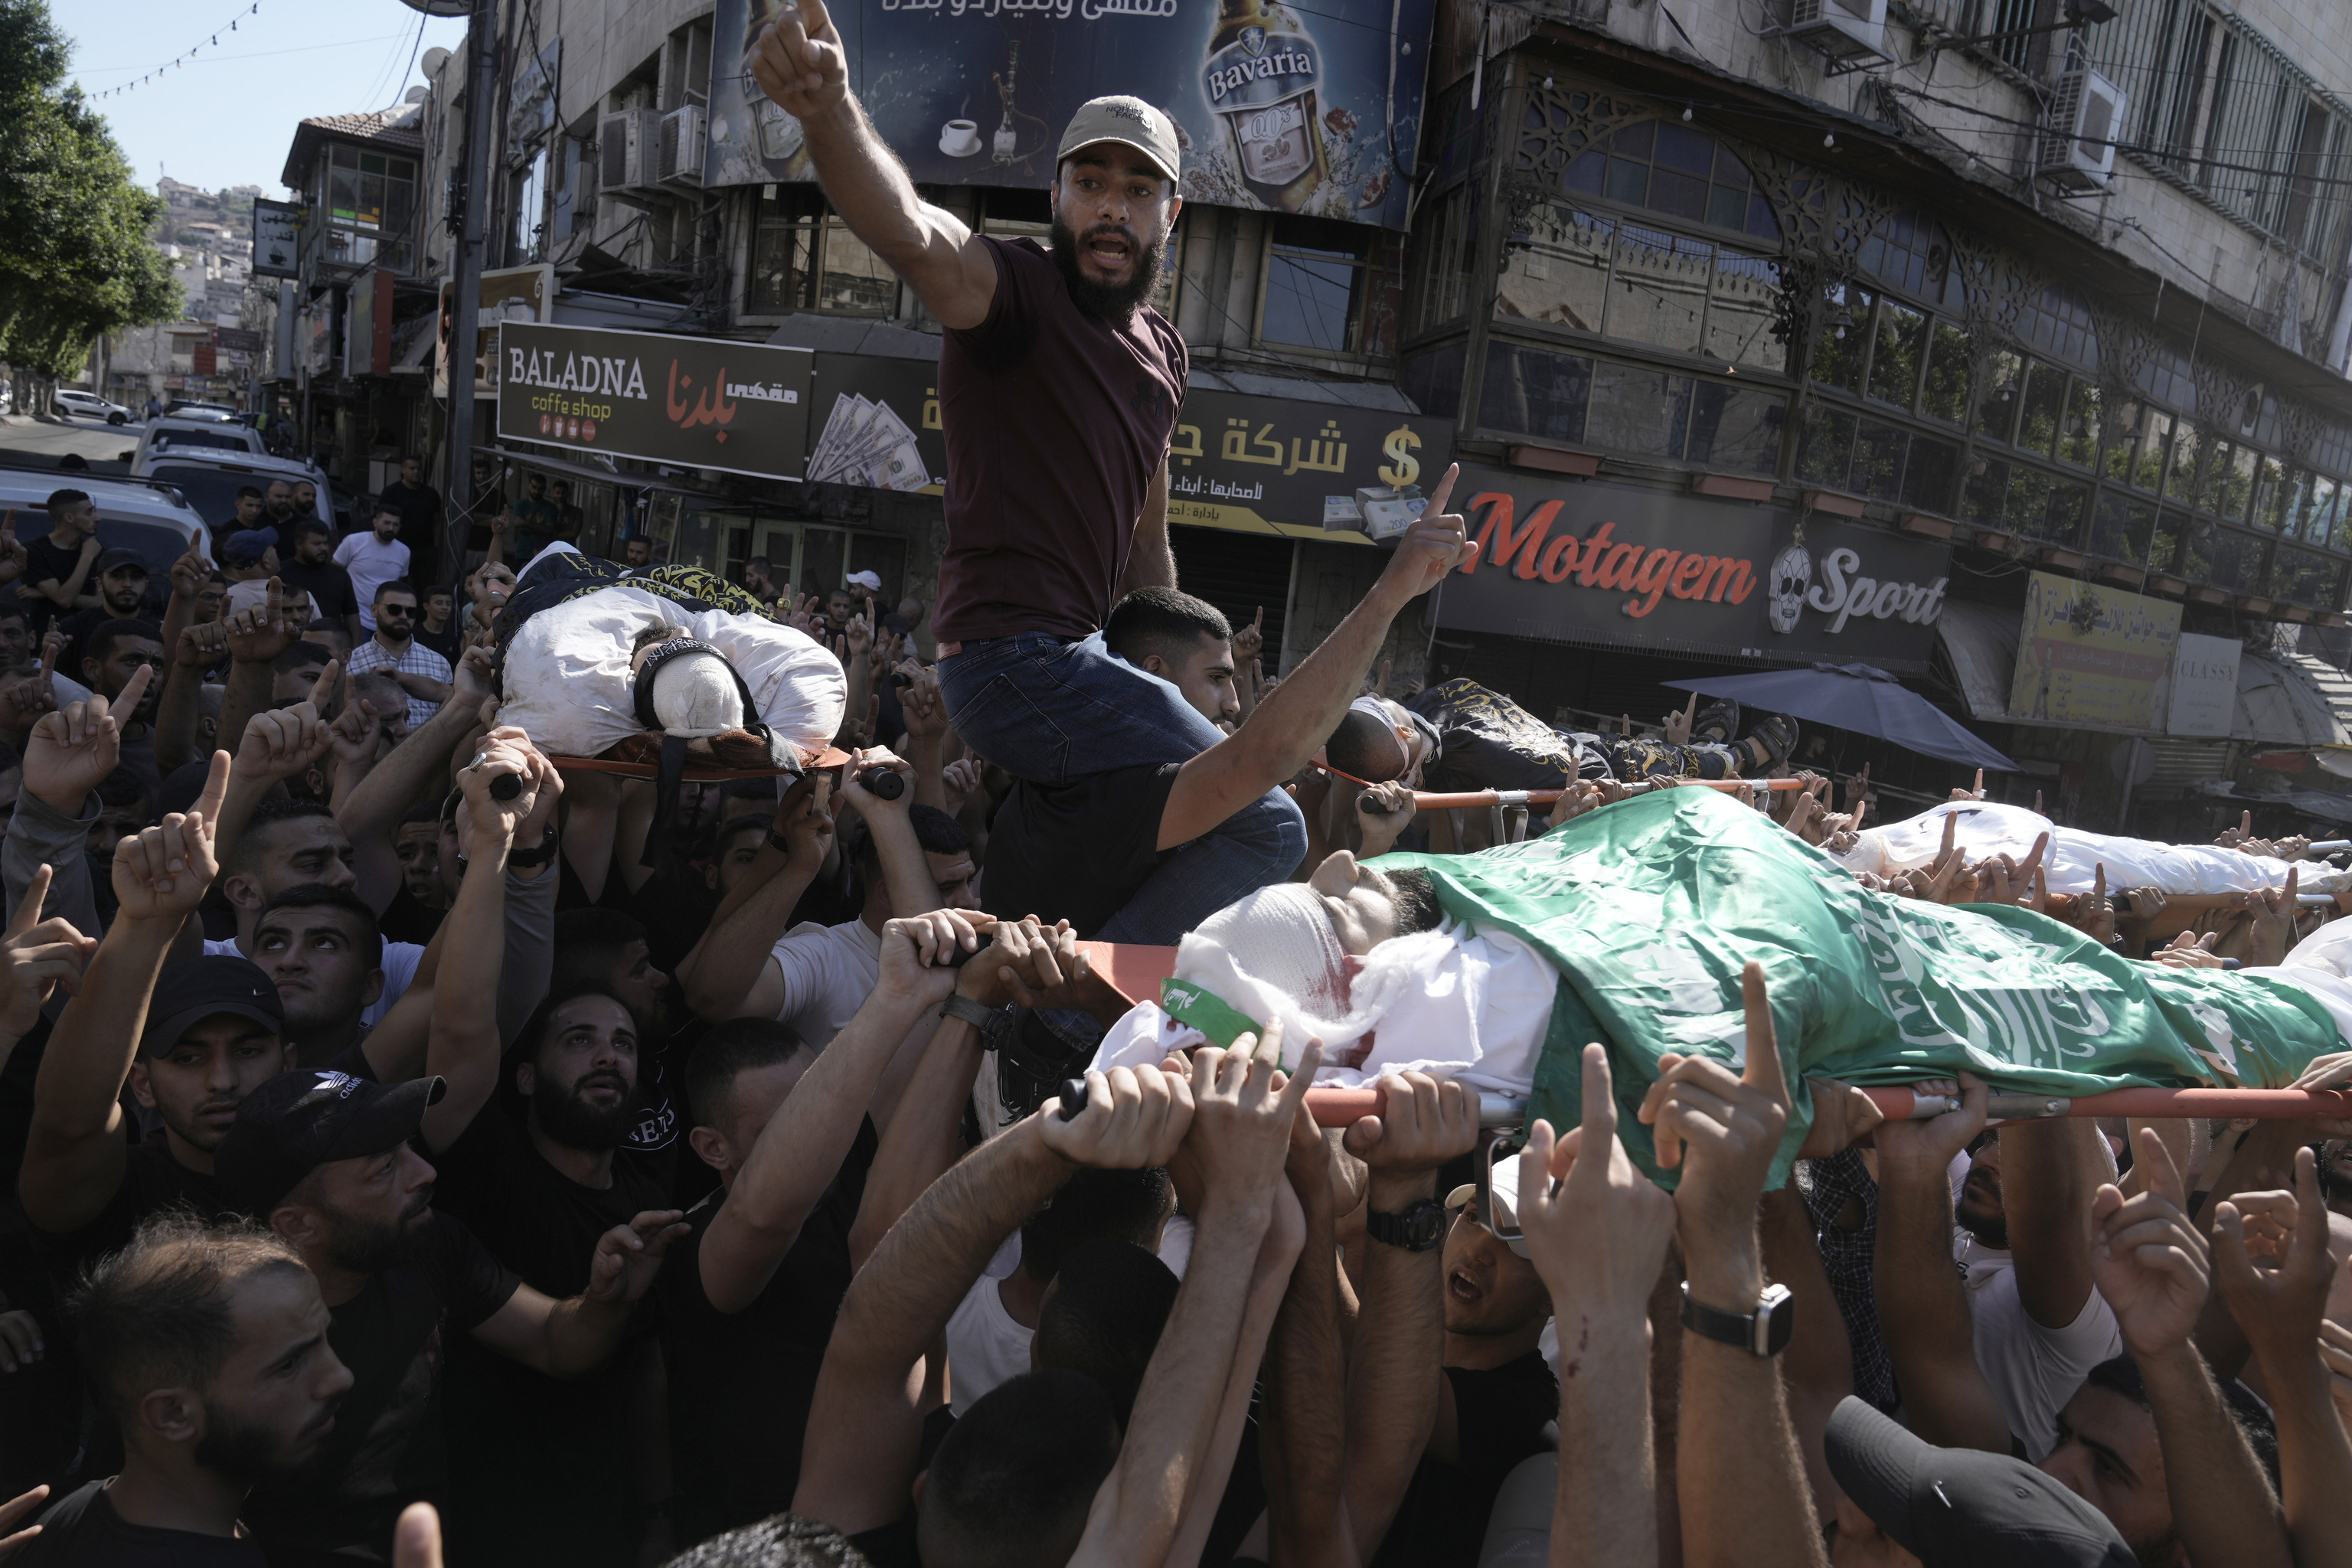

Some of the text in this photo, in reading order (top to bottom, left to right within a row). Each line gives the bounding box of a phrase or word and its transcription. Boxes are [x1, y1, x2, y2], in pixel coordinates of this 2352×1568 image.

[1208, 47, 1314, 101] Bavaria
[261, 213, 294, 224] قهى
[508, 346, 648, 400] BALADNA
[531, 392, 612, 423] coffe shop
[666, 358, 799, 444] مقهى بلدنا
[1221, 418, 1348, 475] شركة
[1168, 502, 1184, 515] أحم
[1389, 518, 1407, 530] 200
[1459, 491, 1949, 634] Motagem Sport
[2180, 661, 2236, 682] CLASSY
[339, 1077, 363, 1099] adida
